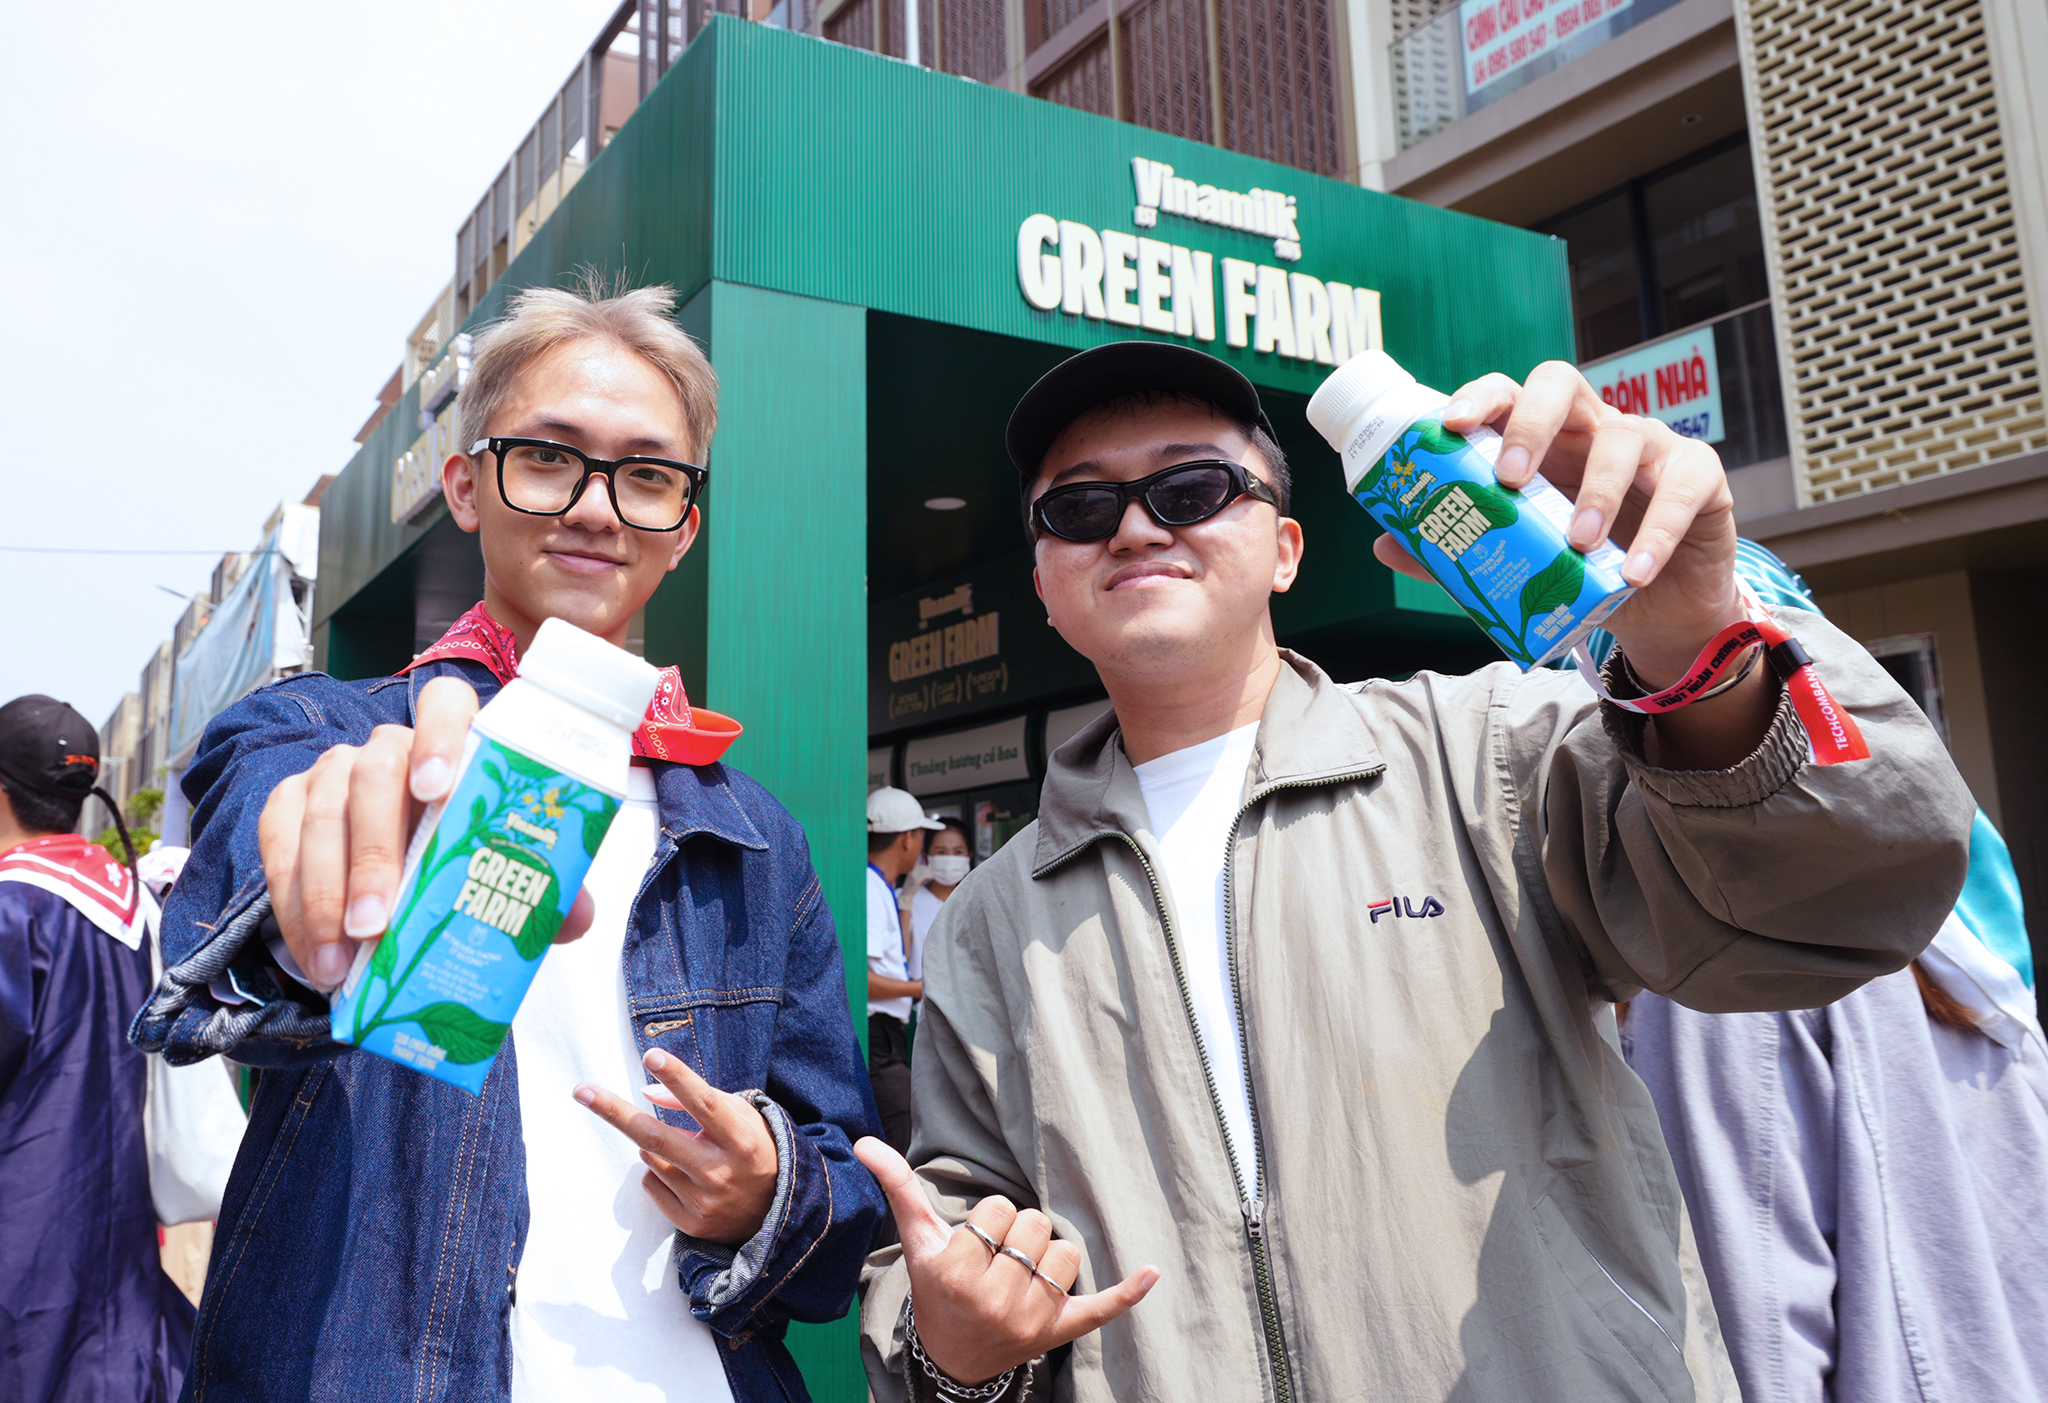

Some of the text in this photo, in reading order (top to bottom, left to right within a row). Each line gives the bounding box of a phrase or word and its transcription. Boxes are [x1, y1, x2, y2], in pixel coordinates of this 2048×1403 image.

[1131, 156, 1300, 241] Vinamilk
[1017, 213, 1384, 368] GREEN FARM
[1655, 344, 1709, 410] NHÀ
[1399, 471, 1435, 506] Vinamilk
[1418, 485, 1475, 544] GREEN
[1437, 506, 1492, 562] FARM
[889, 611, 999, 683] GREEN FARM
[1802, 665, 1849, 750] TECHCOMBANK
[997, 745, 1018, 761] hoa
[467, 846, 552, 908] GREEN
[453, 878, 532, 937] FARM
[1367, 896, 1445, 924] FILA
